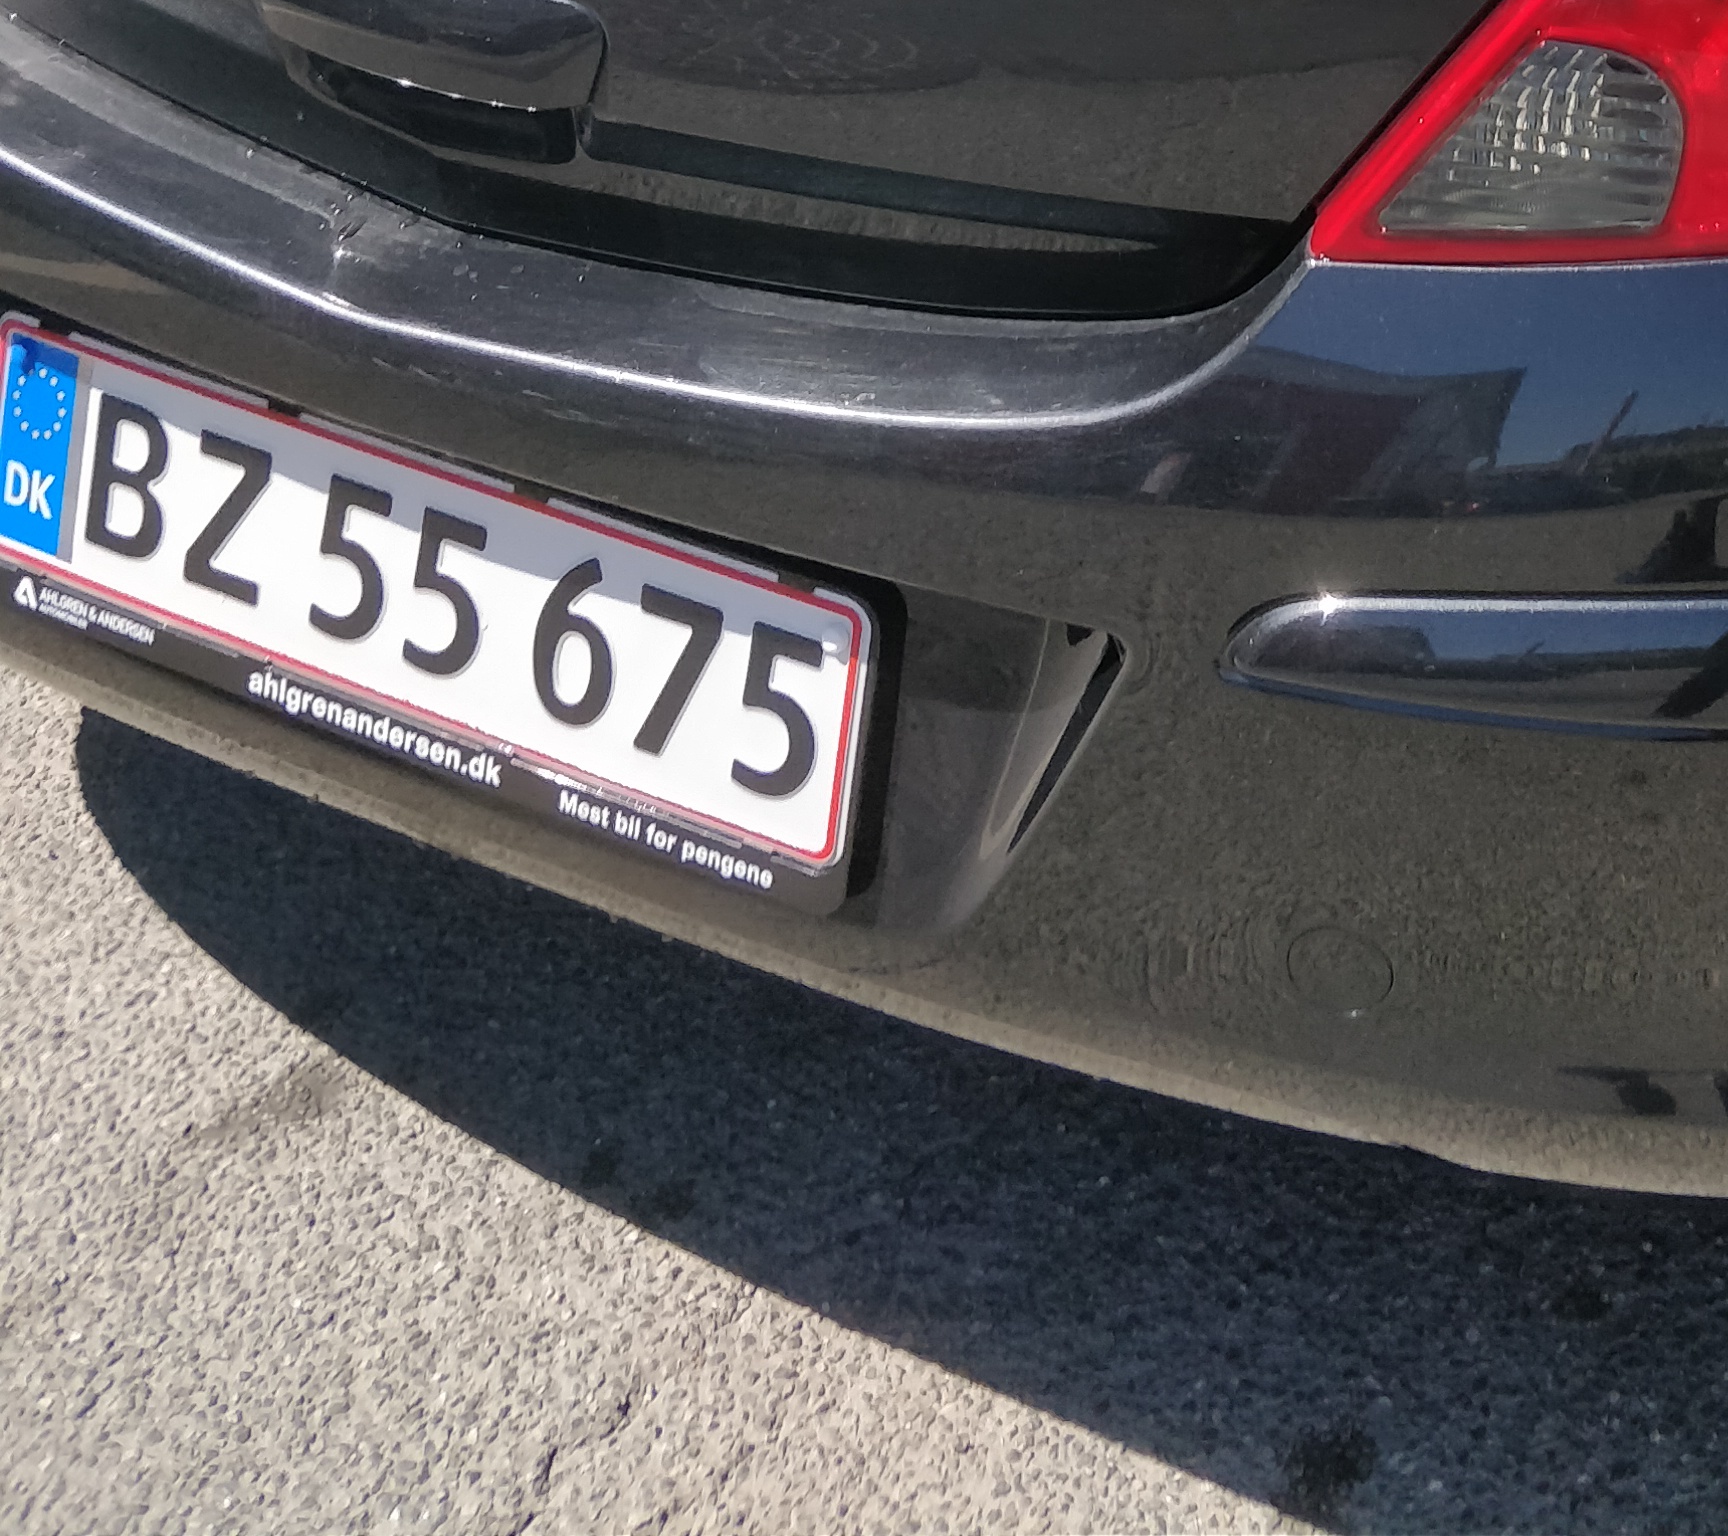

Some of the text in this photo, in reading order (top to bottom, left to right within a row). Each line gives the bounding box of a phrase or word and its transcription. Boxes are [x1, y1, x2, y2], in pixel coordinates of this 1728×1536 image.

[4, 459, 56, 520] DK
[84, 392, 825, 798] BZ 55 675
[248, 671, 502, 788] ahlgrenandersen.dk
[558, 789, 774, 890] Mest bil for pengene
